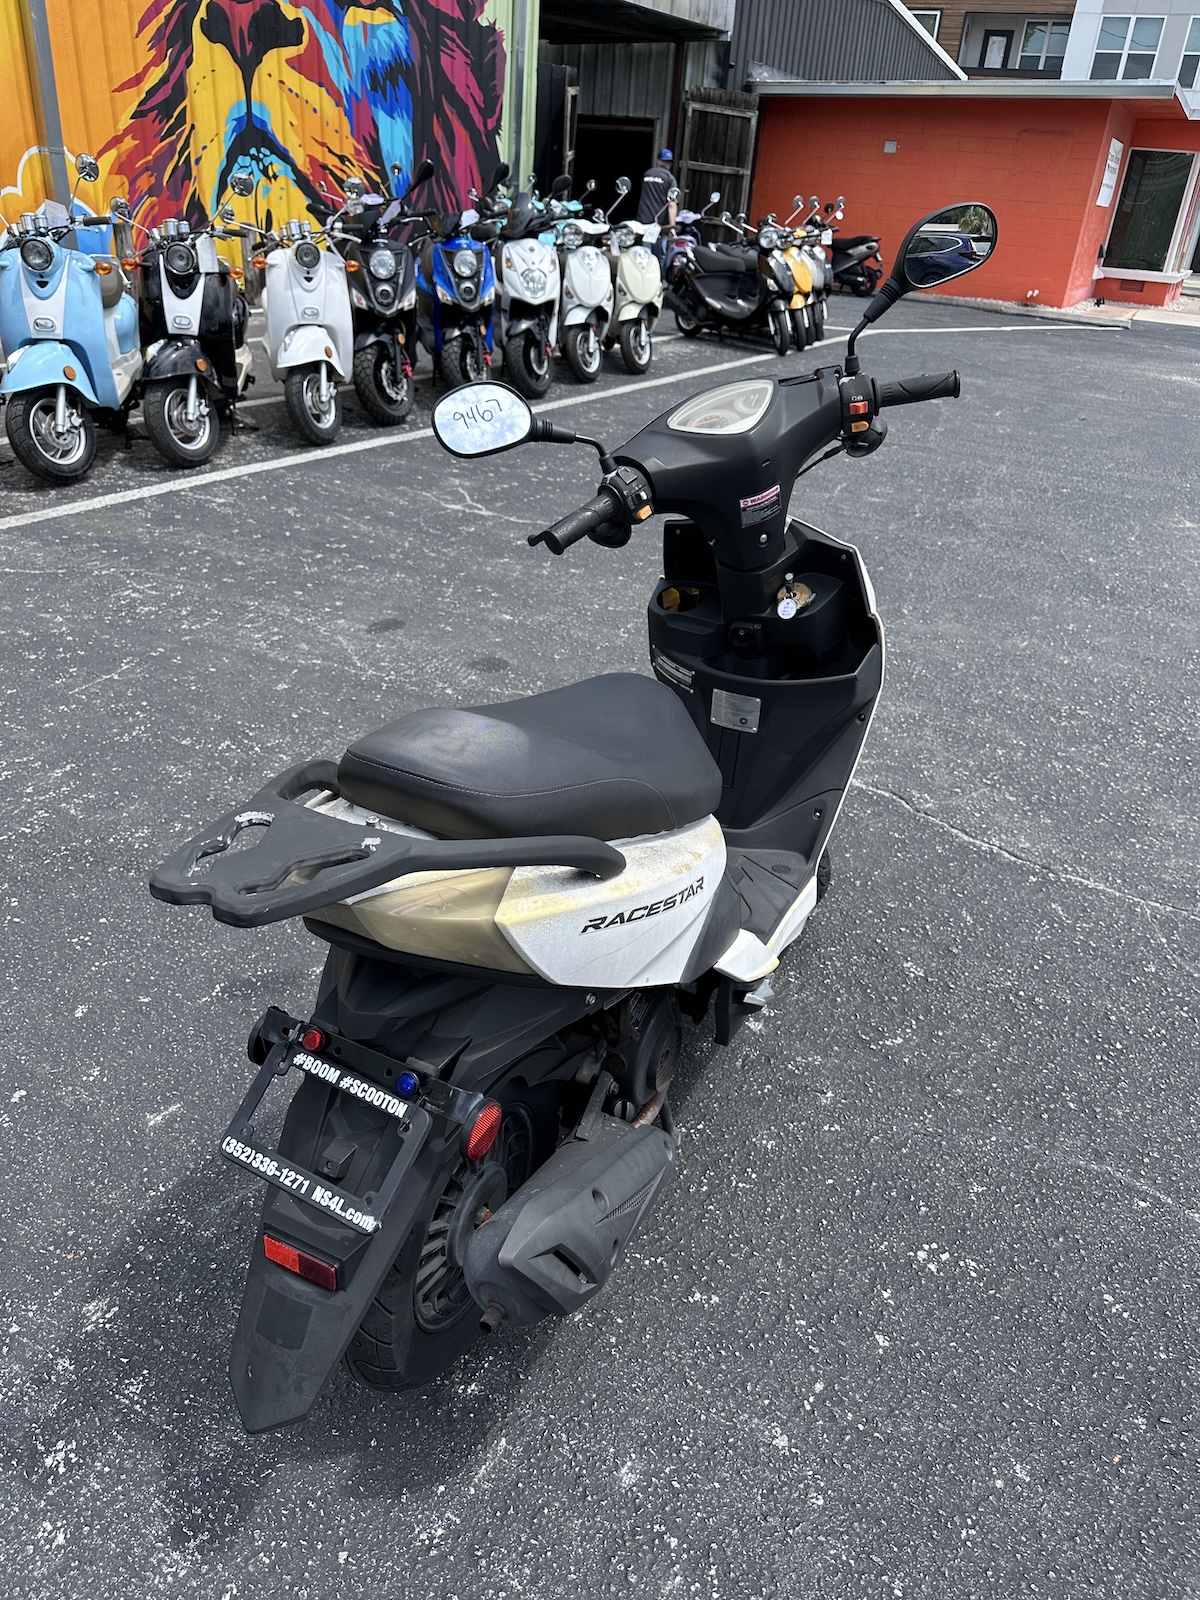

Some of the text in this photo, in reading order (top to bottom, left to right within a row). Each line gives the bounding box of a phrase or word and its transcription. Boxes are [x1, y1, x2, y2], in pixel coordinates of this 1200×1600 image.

[452, 398, 503, 430] 9467
[580, 876, 704, 934] RACESTAR
[292, 1052, 410, 1119] #BOOM #SCOOTON
[221, 1135, 376, 1233] (352)336-1271 NS4L.com
